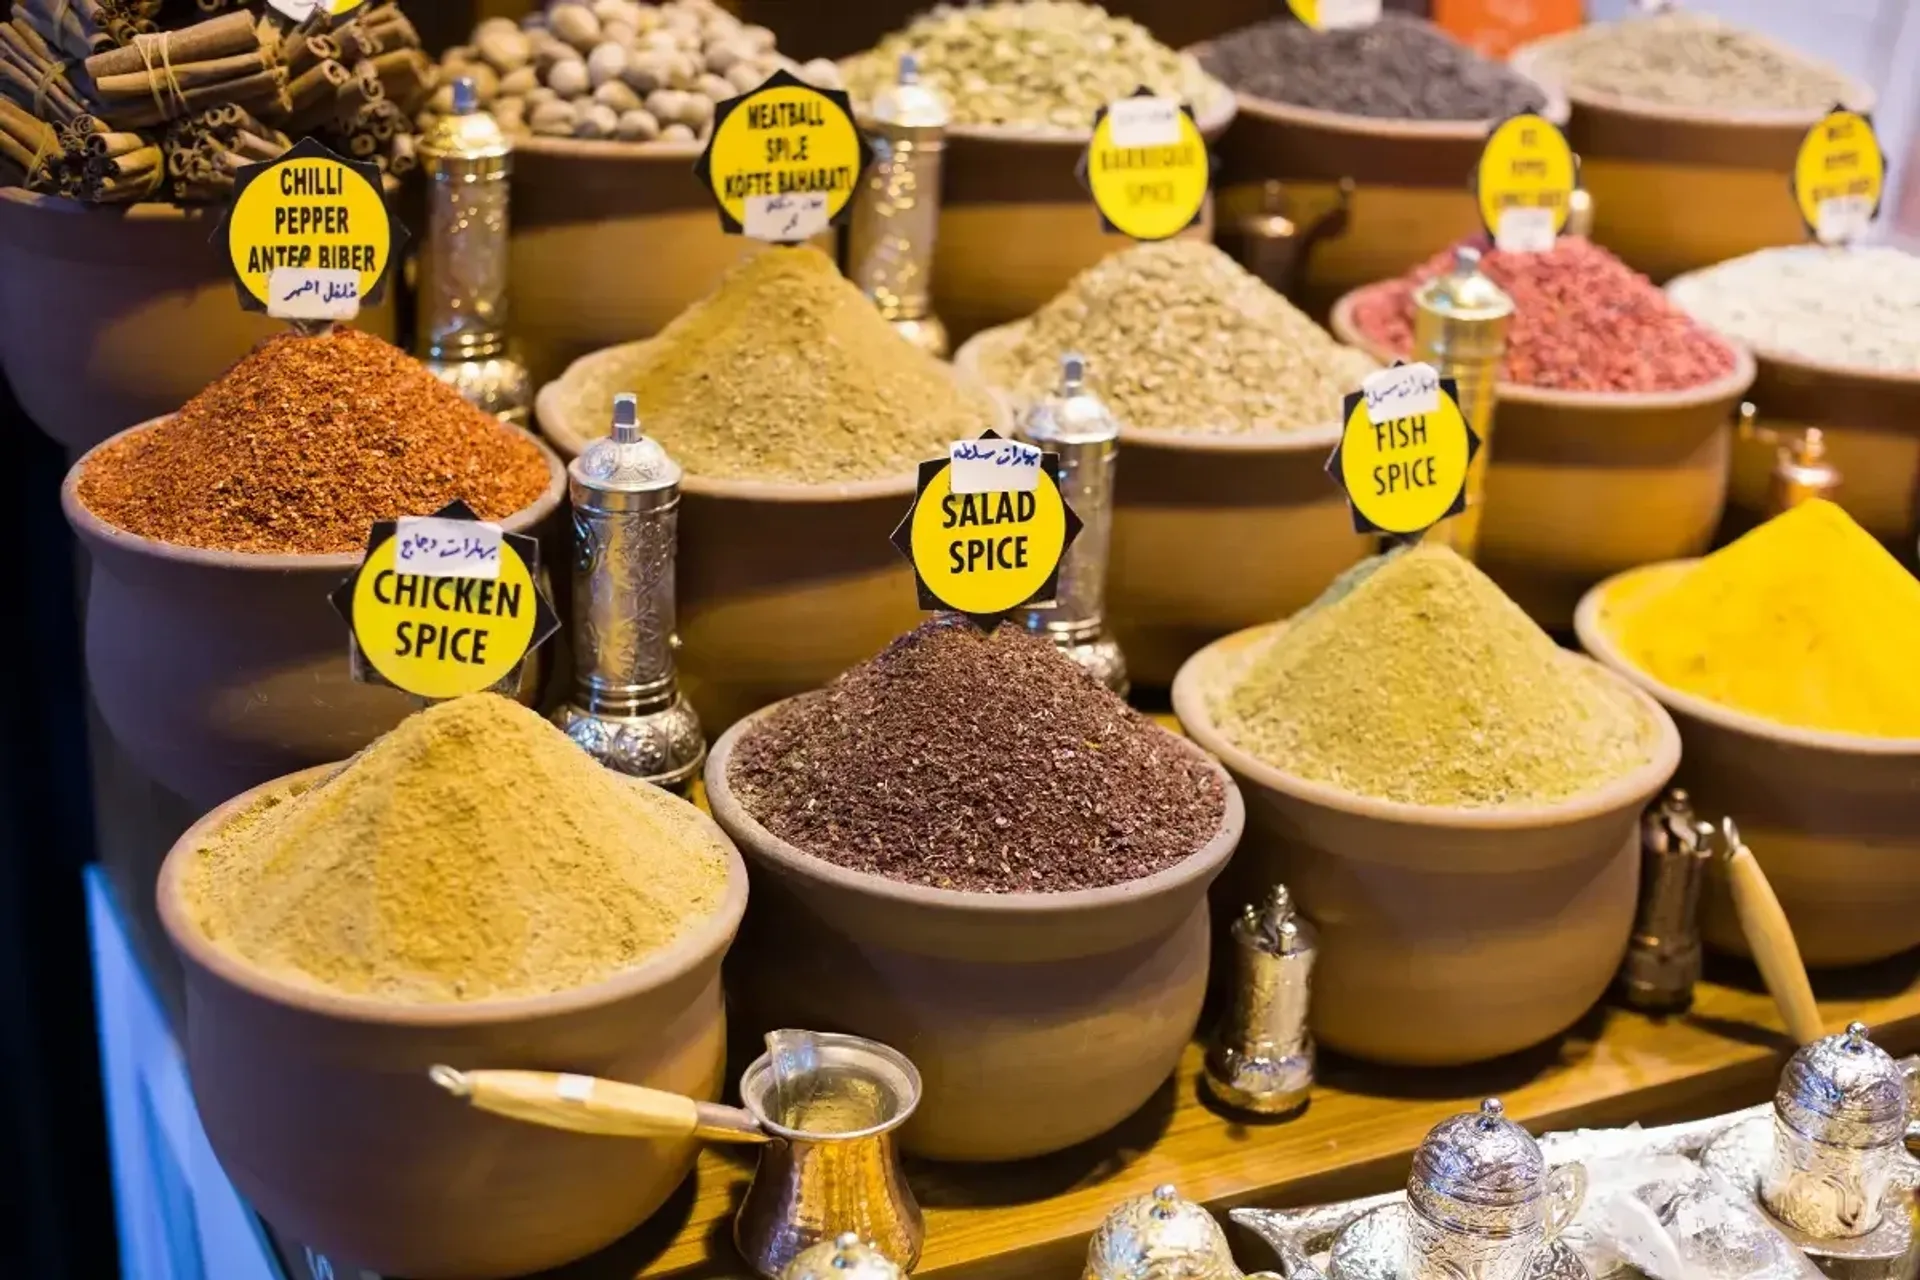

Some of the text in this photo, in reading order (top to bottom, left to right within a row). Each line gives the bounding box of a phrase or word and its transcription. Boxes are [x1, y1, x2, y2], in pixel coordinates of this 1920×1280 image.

[748, 101, 825, 131] MEATBALL
[280, 167, 343, 196] CHILLI
[275, 206, 349, 235] PEPPER
[318, 245, 376, 273] BIBER
[1375, 415, 1428, 452] FISH
[1373, 456, 1437, 496] SPICE
[942, 491, 1036, 529] SALAD
[949, 536, 1029, 575] SPICE
[373, 569, 522, 619] CHICKEN
[395, 621, 489, 665] SPICE
